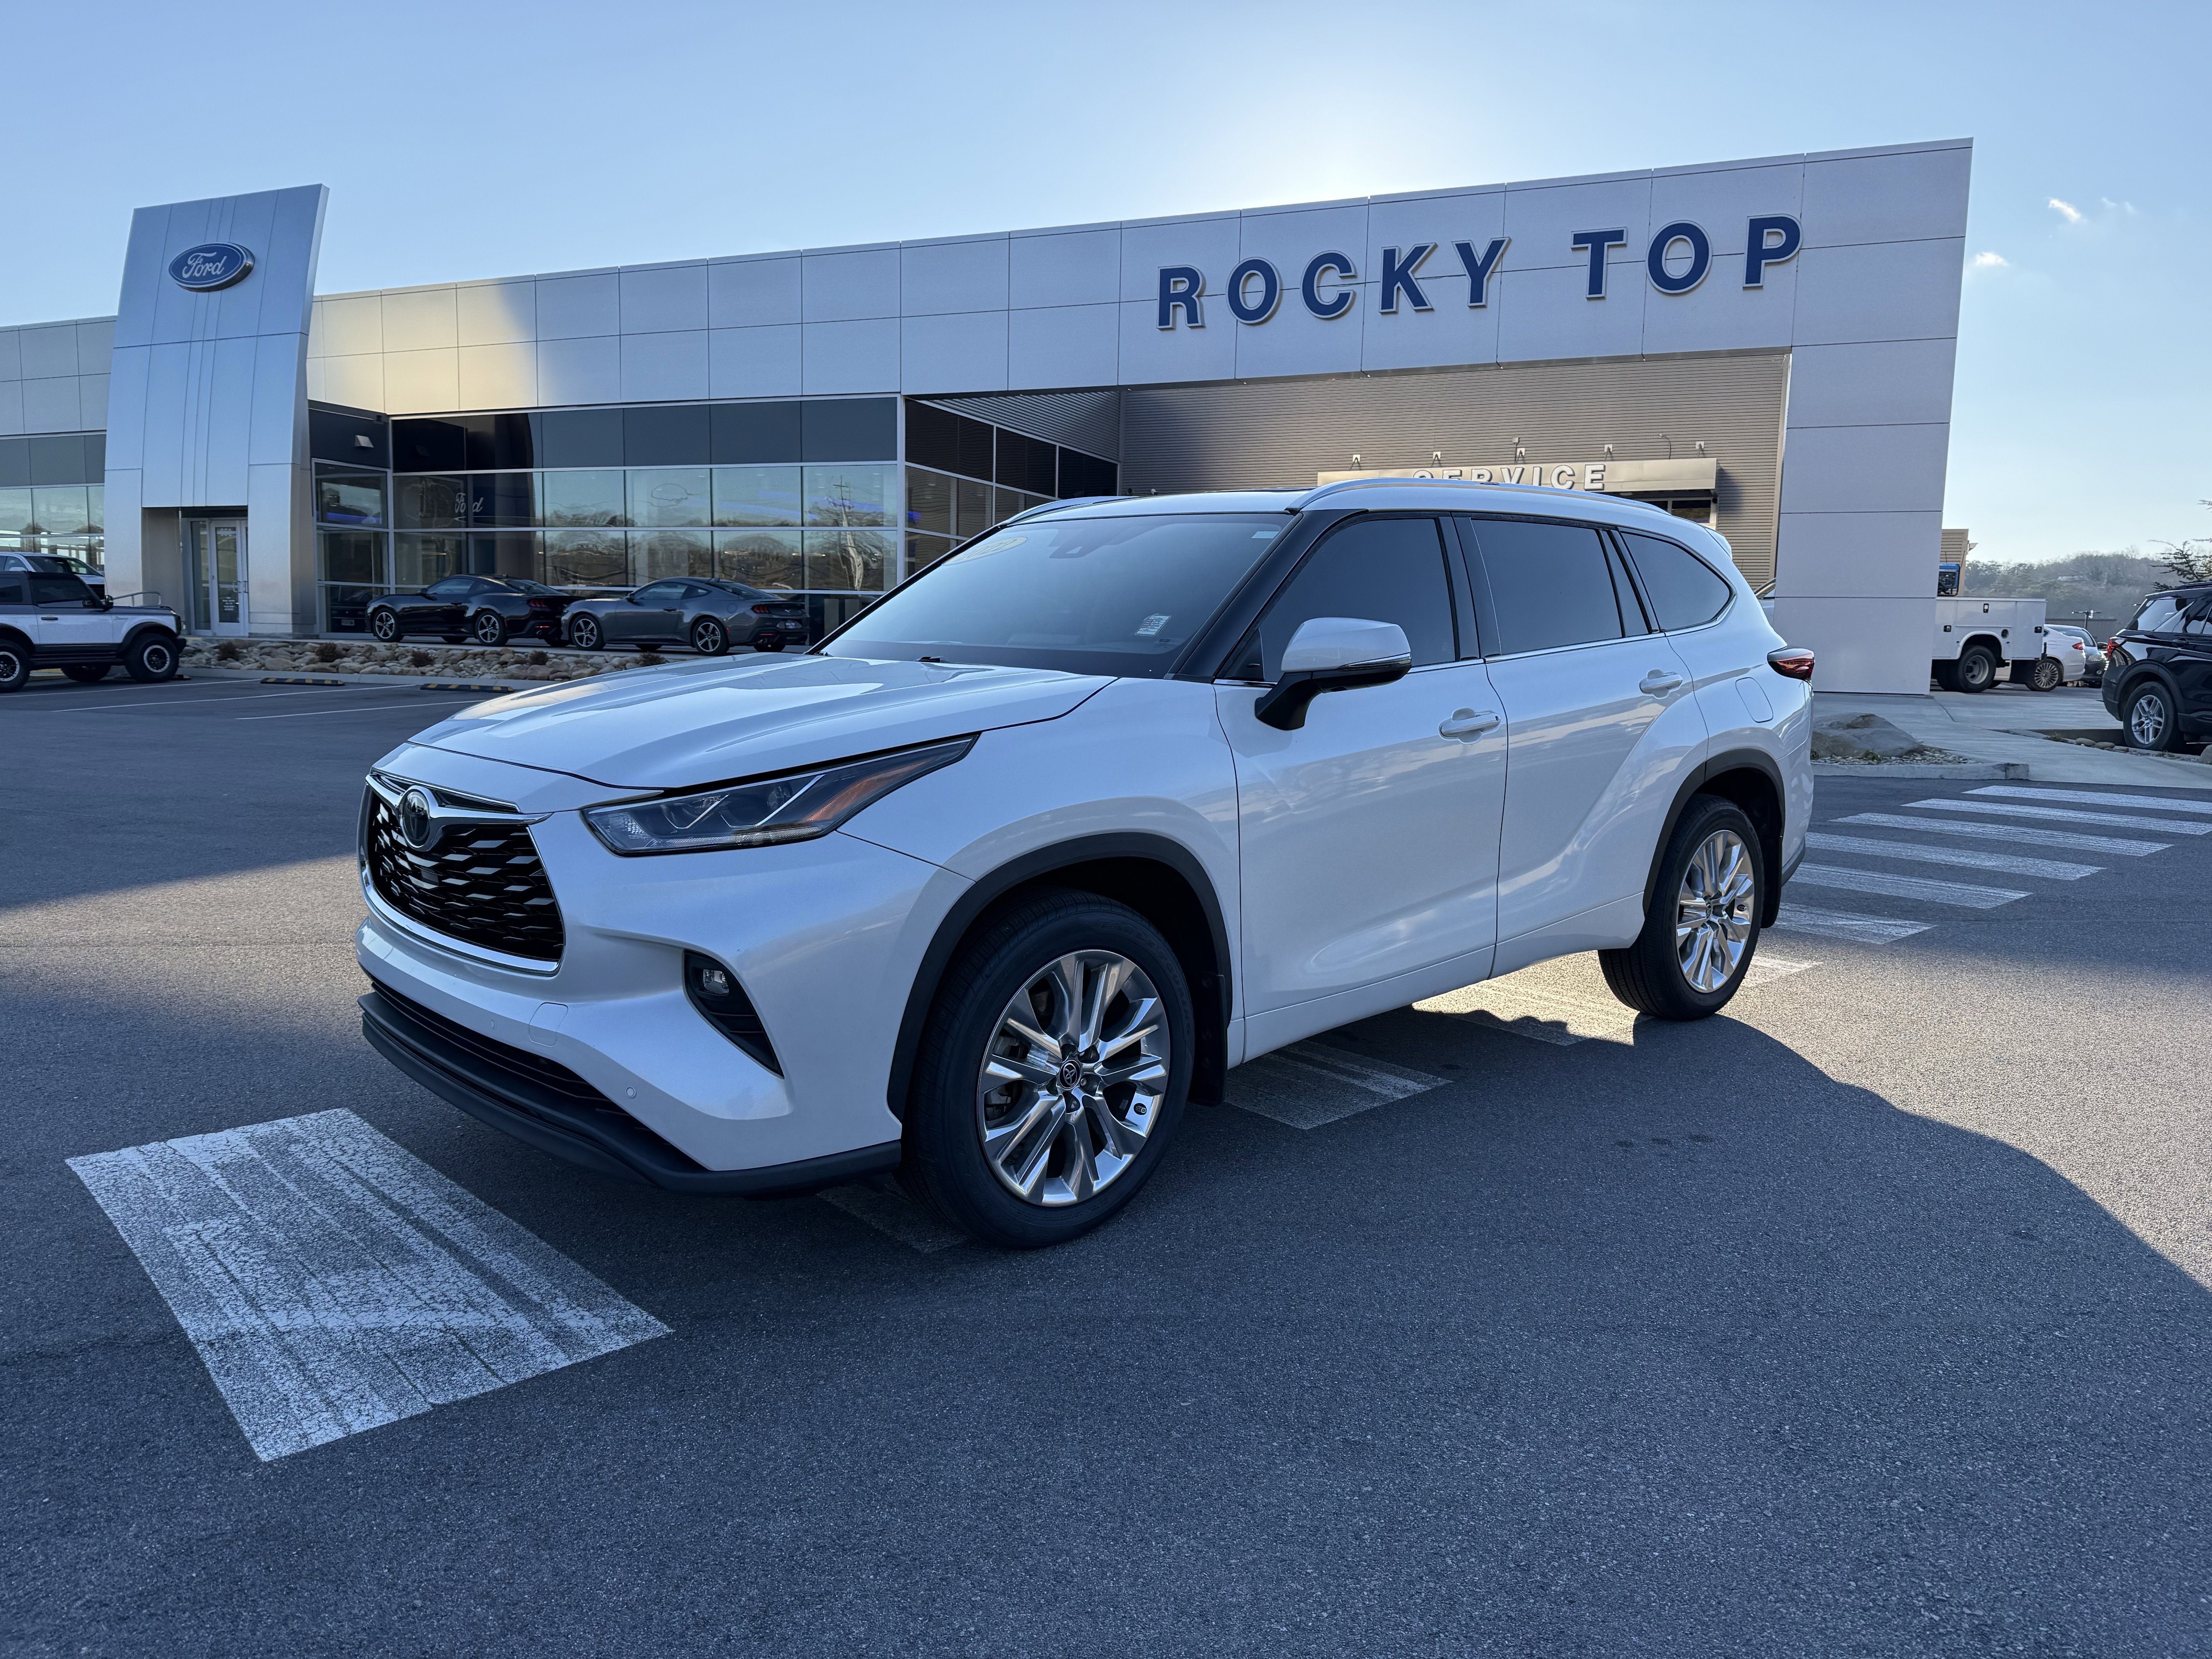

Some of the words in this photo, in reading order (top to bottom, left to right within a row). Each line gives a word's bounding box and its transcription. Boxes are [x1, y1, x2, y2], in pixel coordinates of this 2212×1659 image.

[182, 252, 227, 278] Ford
[1156, 237, 1512, 330] ROCKY
[1571, 213, 1802, 300] TOP
[455, 492, 484, 514] Fod
